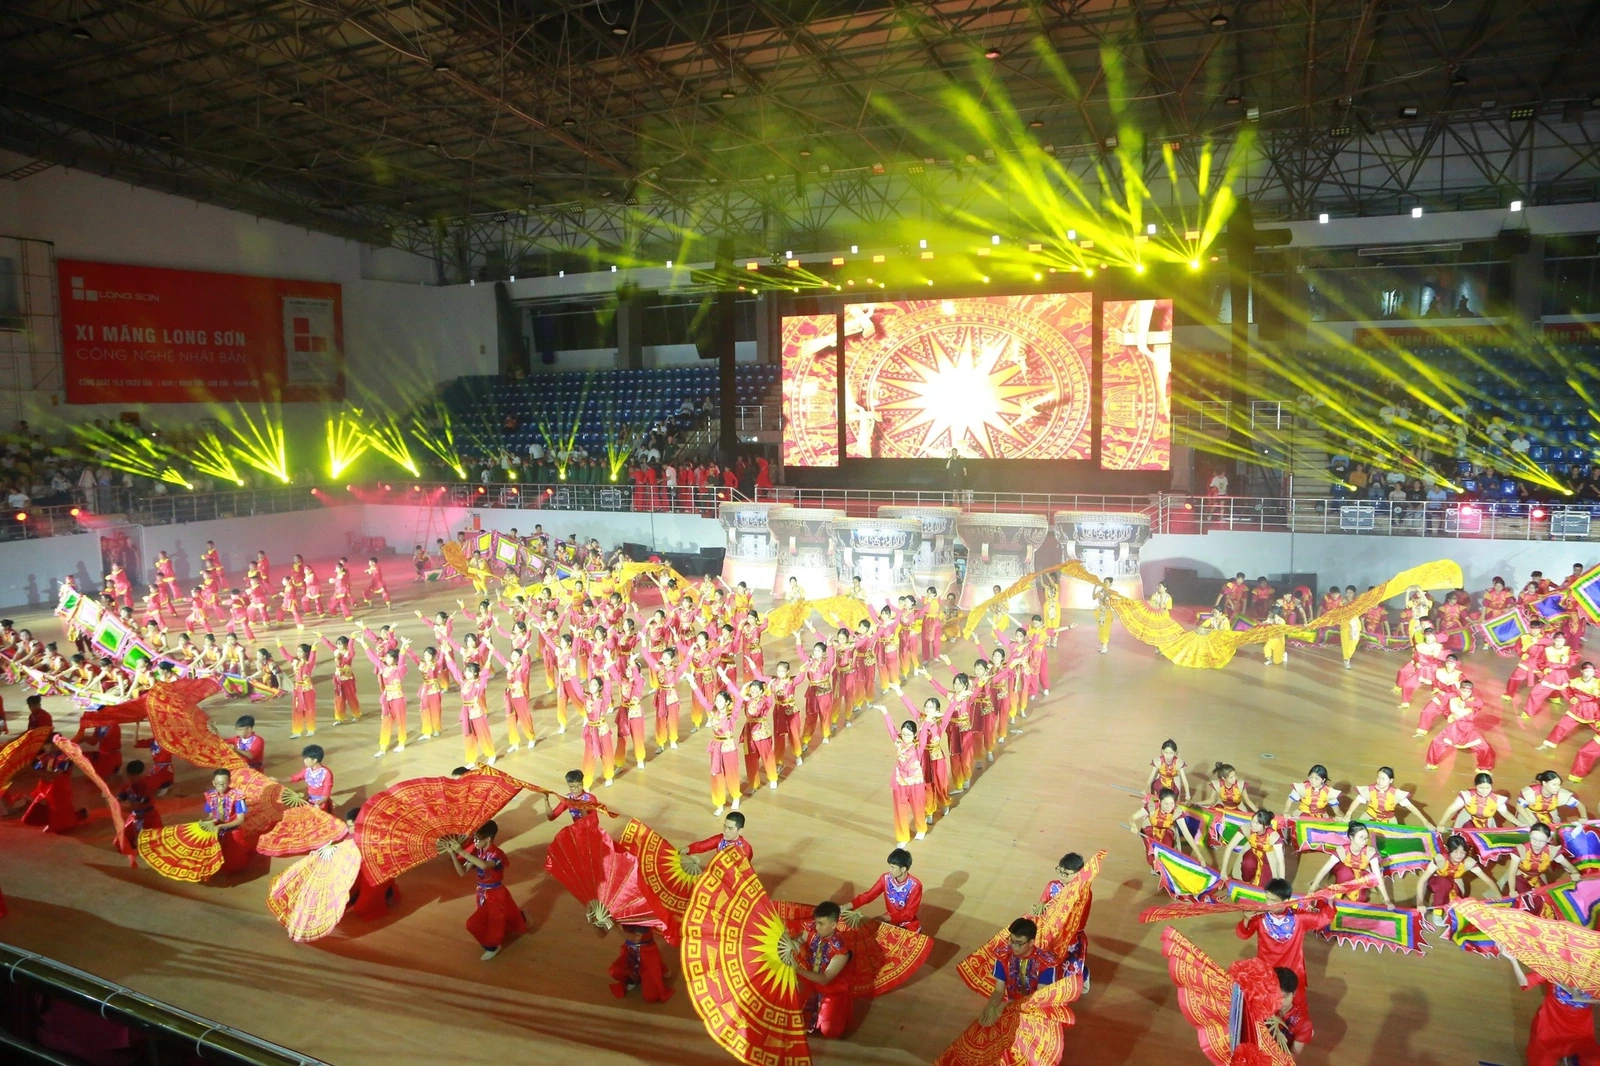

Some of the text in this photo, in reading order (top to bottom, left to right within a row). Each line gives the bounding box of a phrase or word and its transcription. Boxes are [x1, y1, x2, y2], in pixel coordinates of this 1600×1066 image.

[98, 291, 132, 300] LONG
[75, 324, 246, 347] XI MĂNG LONG SƠN
[77, 346, 246, 364] CÔNG NGHỆ NHẬT BẢN
